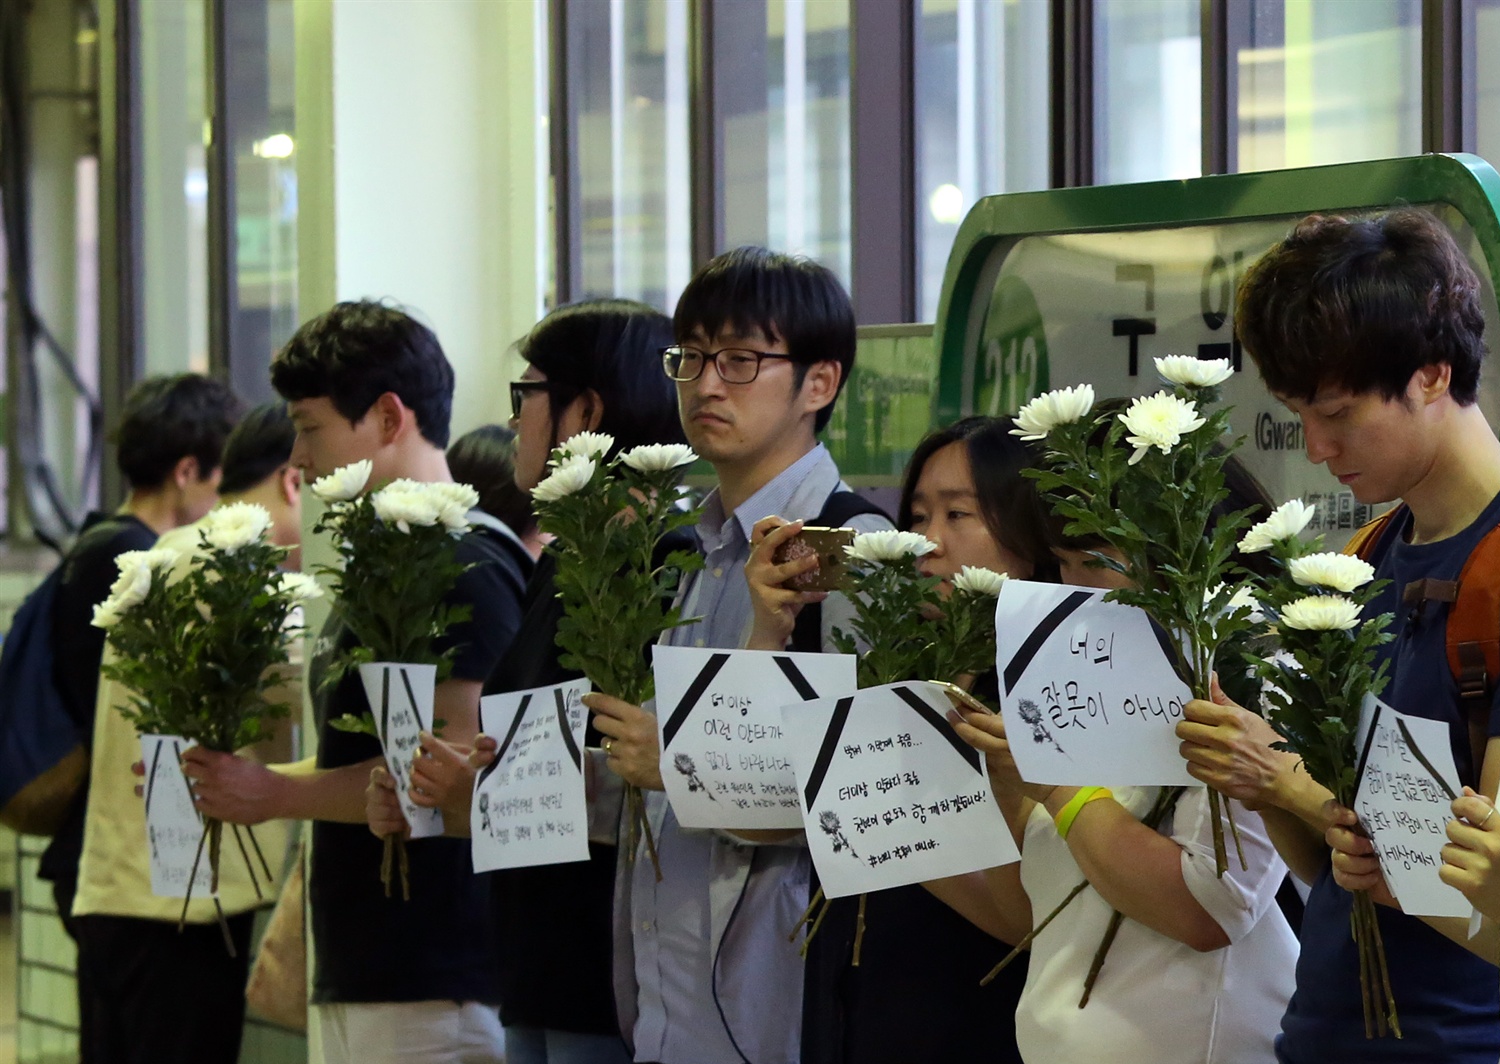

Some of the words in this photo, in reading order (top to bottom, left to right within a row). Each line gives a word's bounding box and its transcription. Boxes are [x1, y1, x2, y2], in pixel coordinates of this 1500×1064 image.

[1070, 631, 1114, 669] 너의
[1041, 681, 1109, 729] 잘못이
[704, 719, 732, 741] 이런
